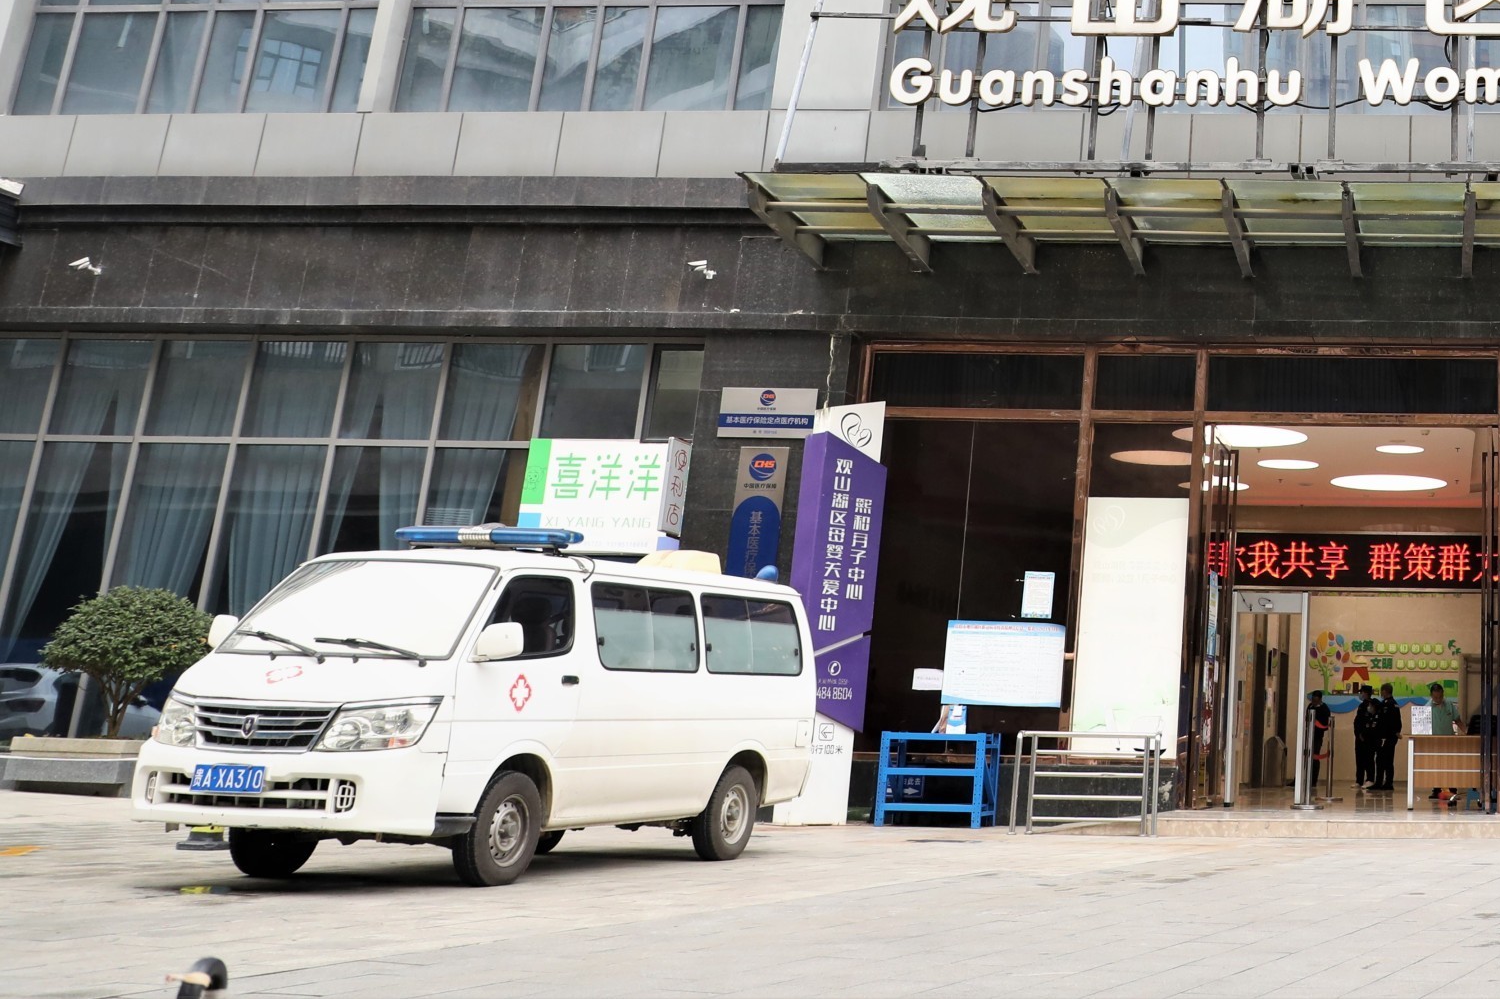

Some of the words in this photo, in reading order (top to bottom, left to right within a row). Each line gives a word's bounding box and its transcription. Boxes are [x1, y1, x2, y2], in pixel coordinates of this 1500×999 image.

[889, 56, 1302, 107] Guanshanhu
[551, 453, 661, 501] 喜洋洋
[753, 460, 775, 469] CHS
[545, 516, 559, 527] XI
[566, 517, 605, 528] YANG
[611, 517, 651, 529] YANG
[817, 458, 854, 632] 观山湖区母婴关爱中心
[845, 497, 873, 601] 熙和月子中心
[832, 687, 853, 700] 8604
